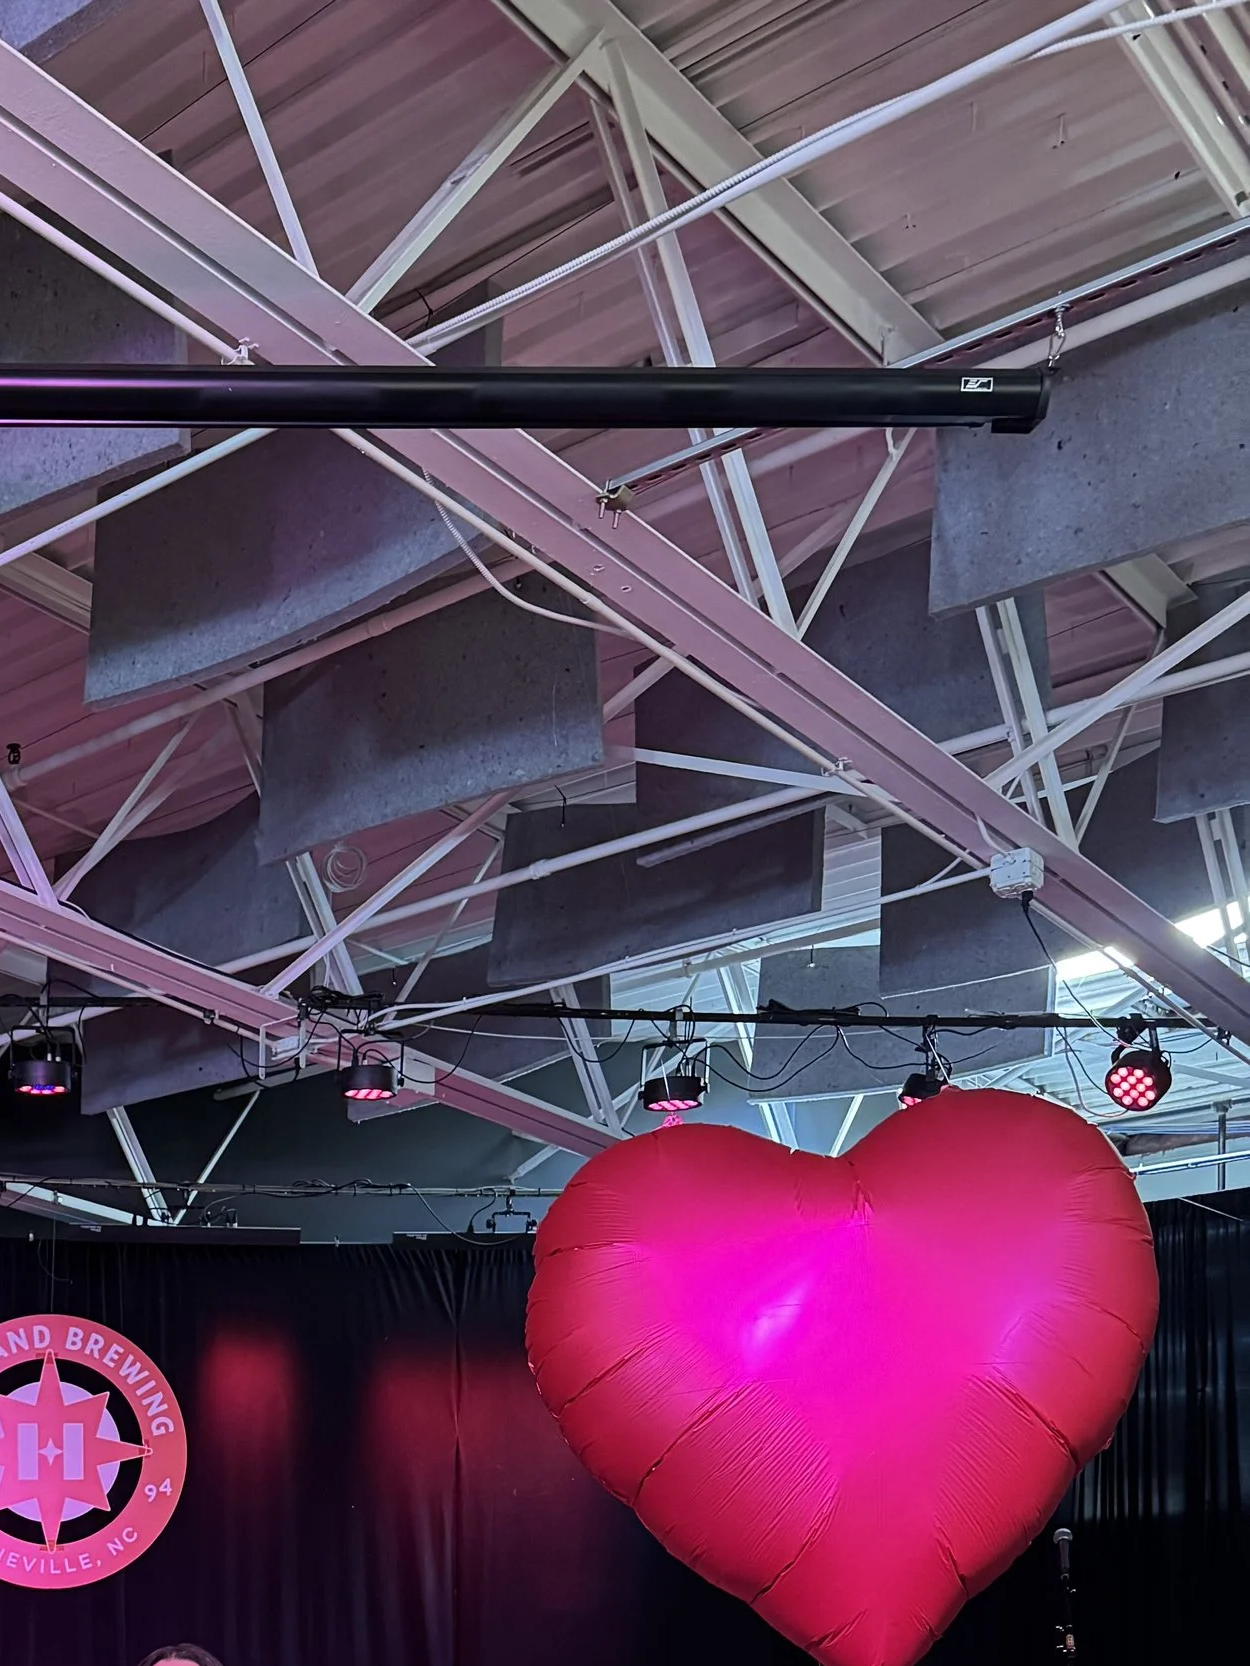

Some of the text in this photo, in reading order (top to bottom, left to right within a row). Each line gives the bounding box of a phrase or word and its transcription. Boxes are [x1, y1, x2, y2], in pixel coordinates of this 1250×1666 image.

[65, 1326, 175, 1437] BREWING
[144, 1478, 172, 1503] 94
[107, 1527, 138, 1556] NC
